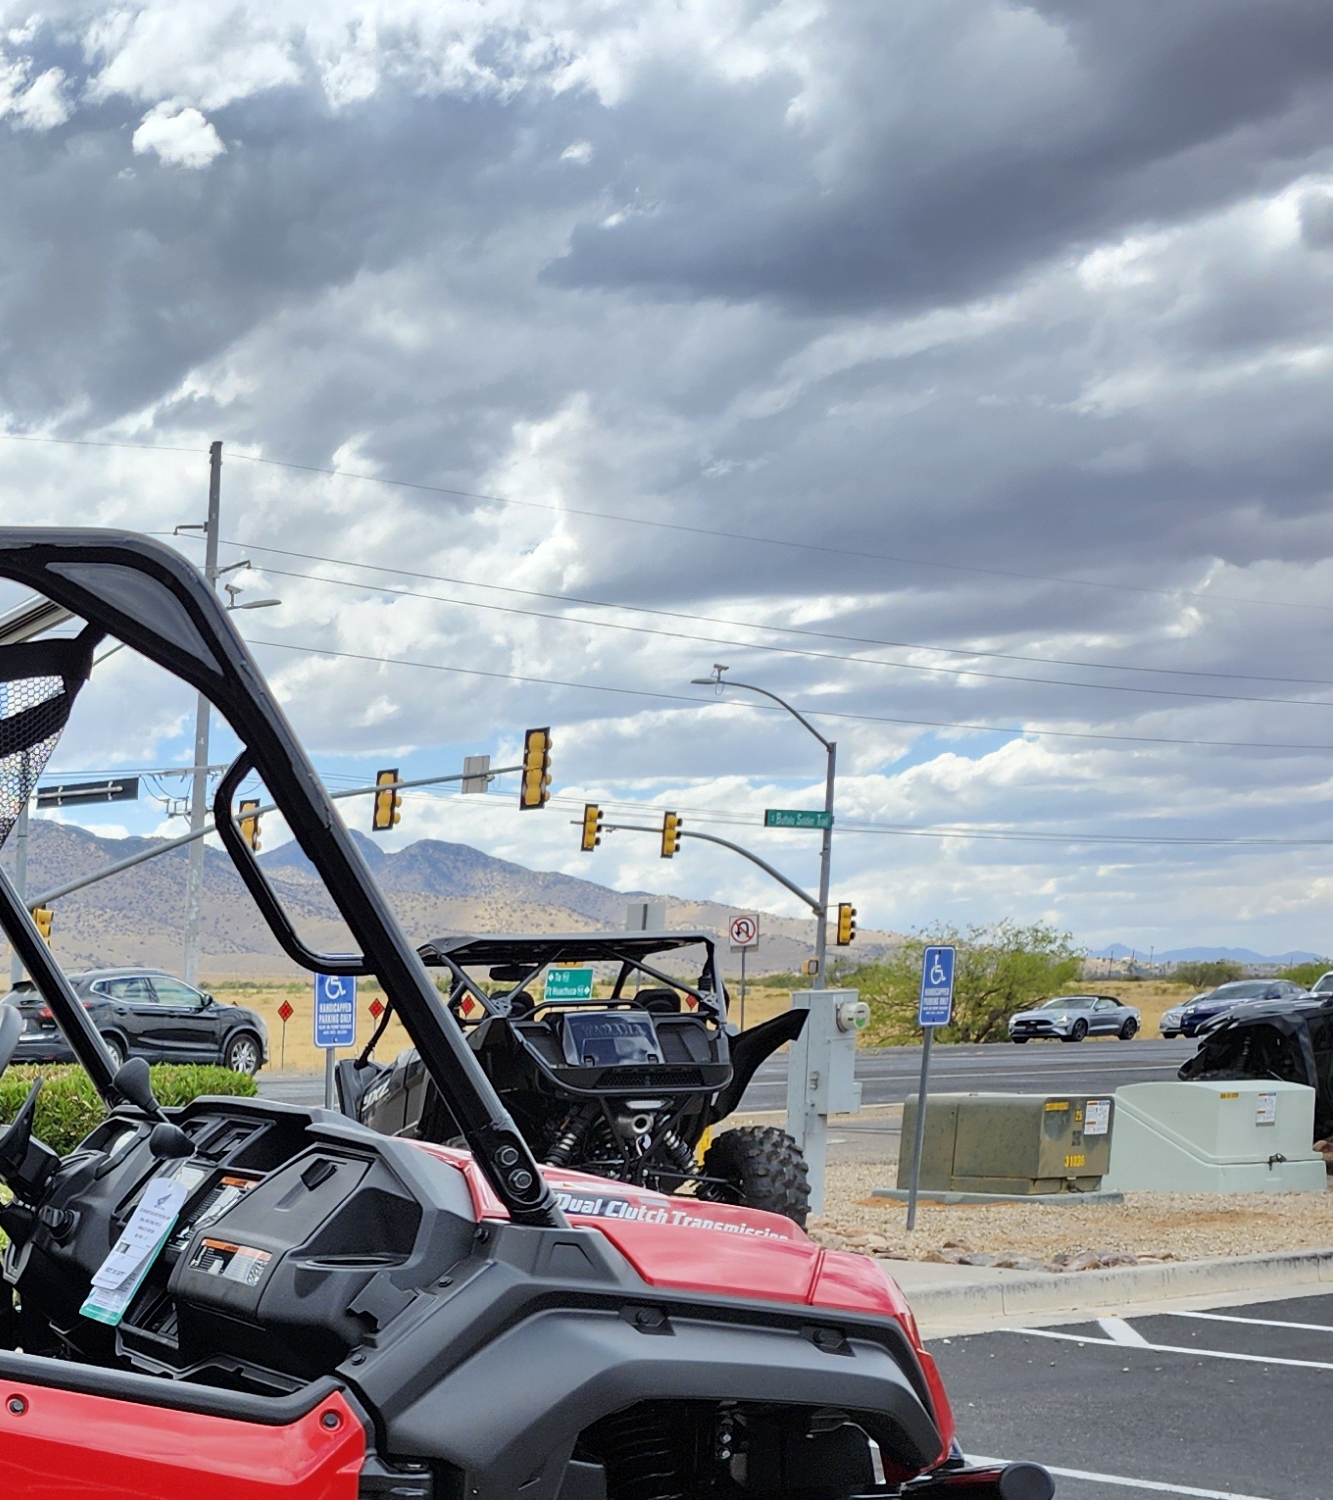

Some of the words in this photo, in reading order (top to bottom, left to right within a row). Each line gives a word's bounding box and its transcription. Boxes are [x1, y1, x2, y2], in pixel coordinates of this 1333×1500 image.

[776, 811, 795, 826] Buffalo
[796, 812, 815, 826] Soldier
[816, 813, 829, 826] Trail
[319, 1002, 352, 1013] HANDICAPPED
[318, 1013, 339, 1024] PARKING
[339, 1013, 352, 1024] ONLY
[555, 1192, 602, 1215] Dual
[604, 1200, 668, 1225] Clutch
